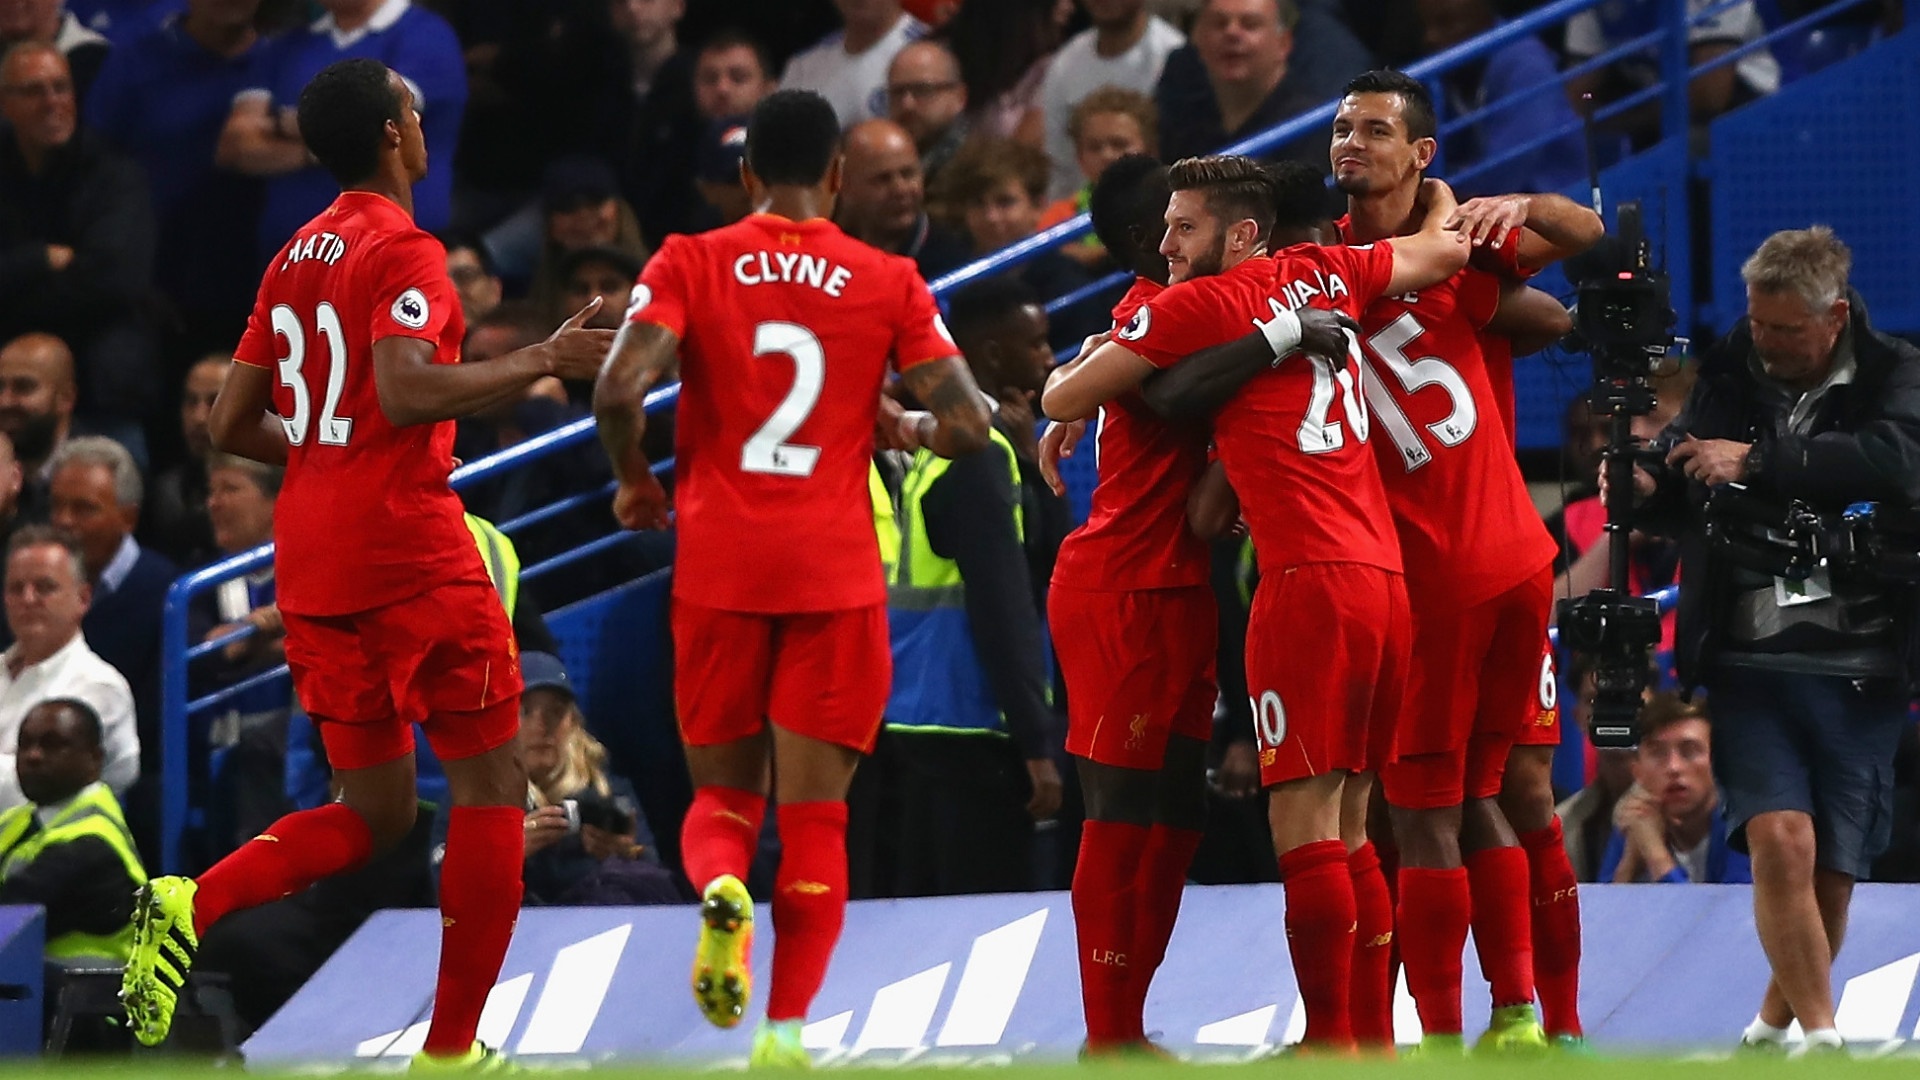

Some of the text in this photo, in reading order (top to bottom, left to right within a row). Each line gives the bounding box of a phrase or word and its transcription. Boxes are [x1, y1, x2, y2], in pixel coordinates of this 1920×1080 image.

[734, 251, 853, 298] CLYNE
[270, 301, 353, 447] 32
[740, 320, 827, 478] 2
[1362, 311, 1478, 473] 15
[1538, 652, 1557, 710] 6
